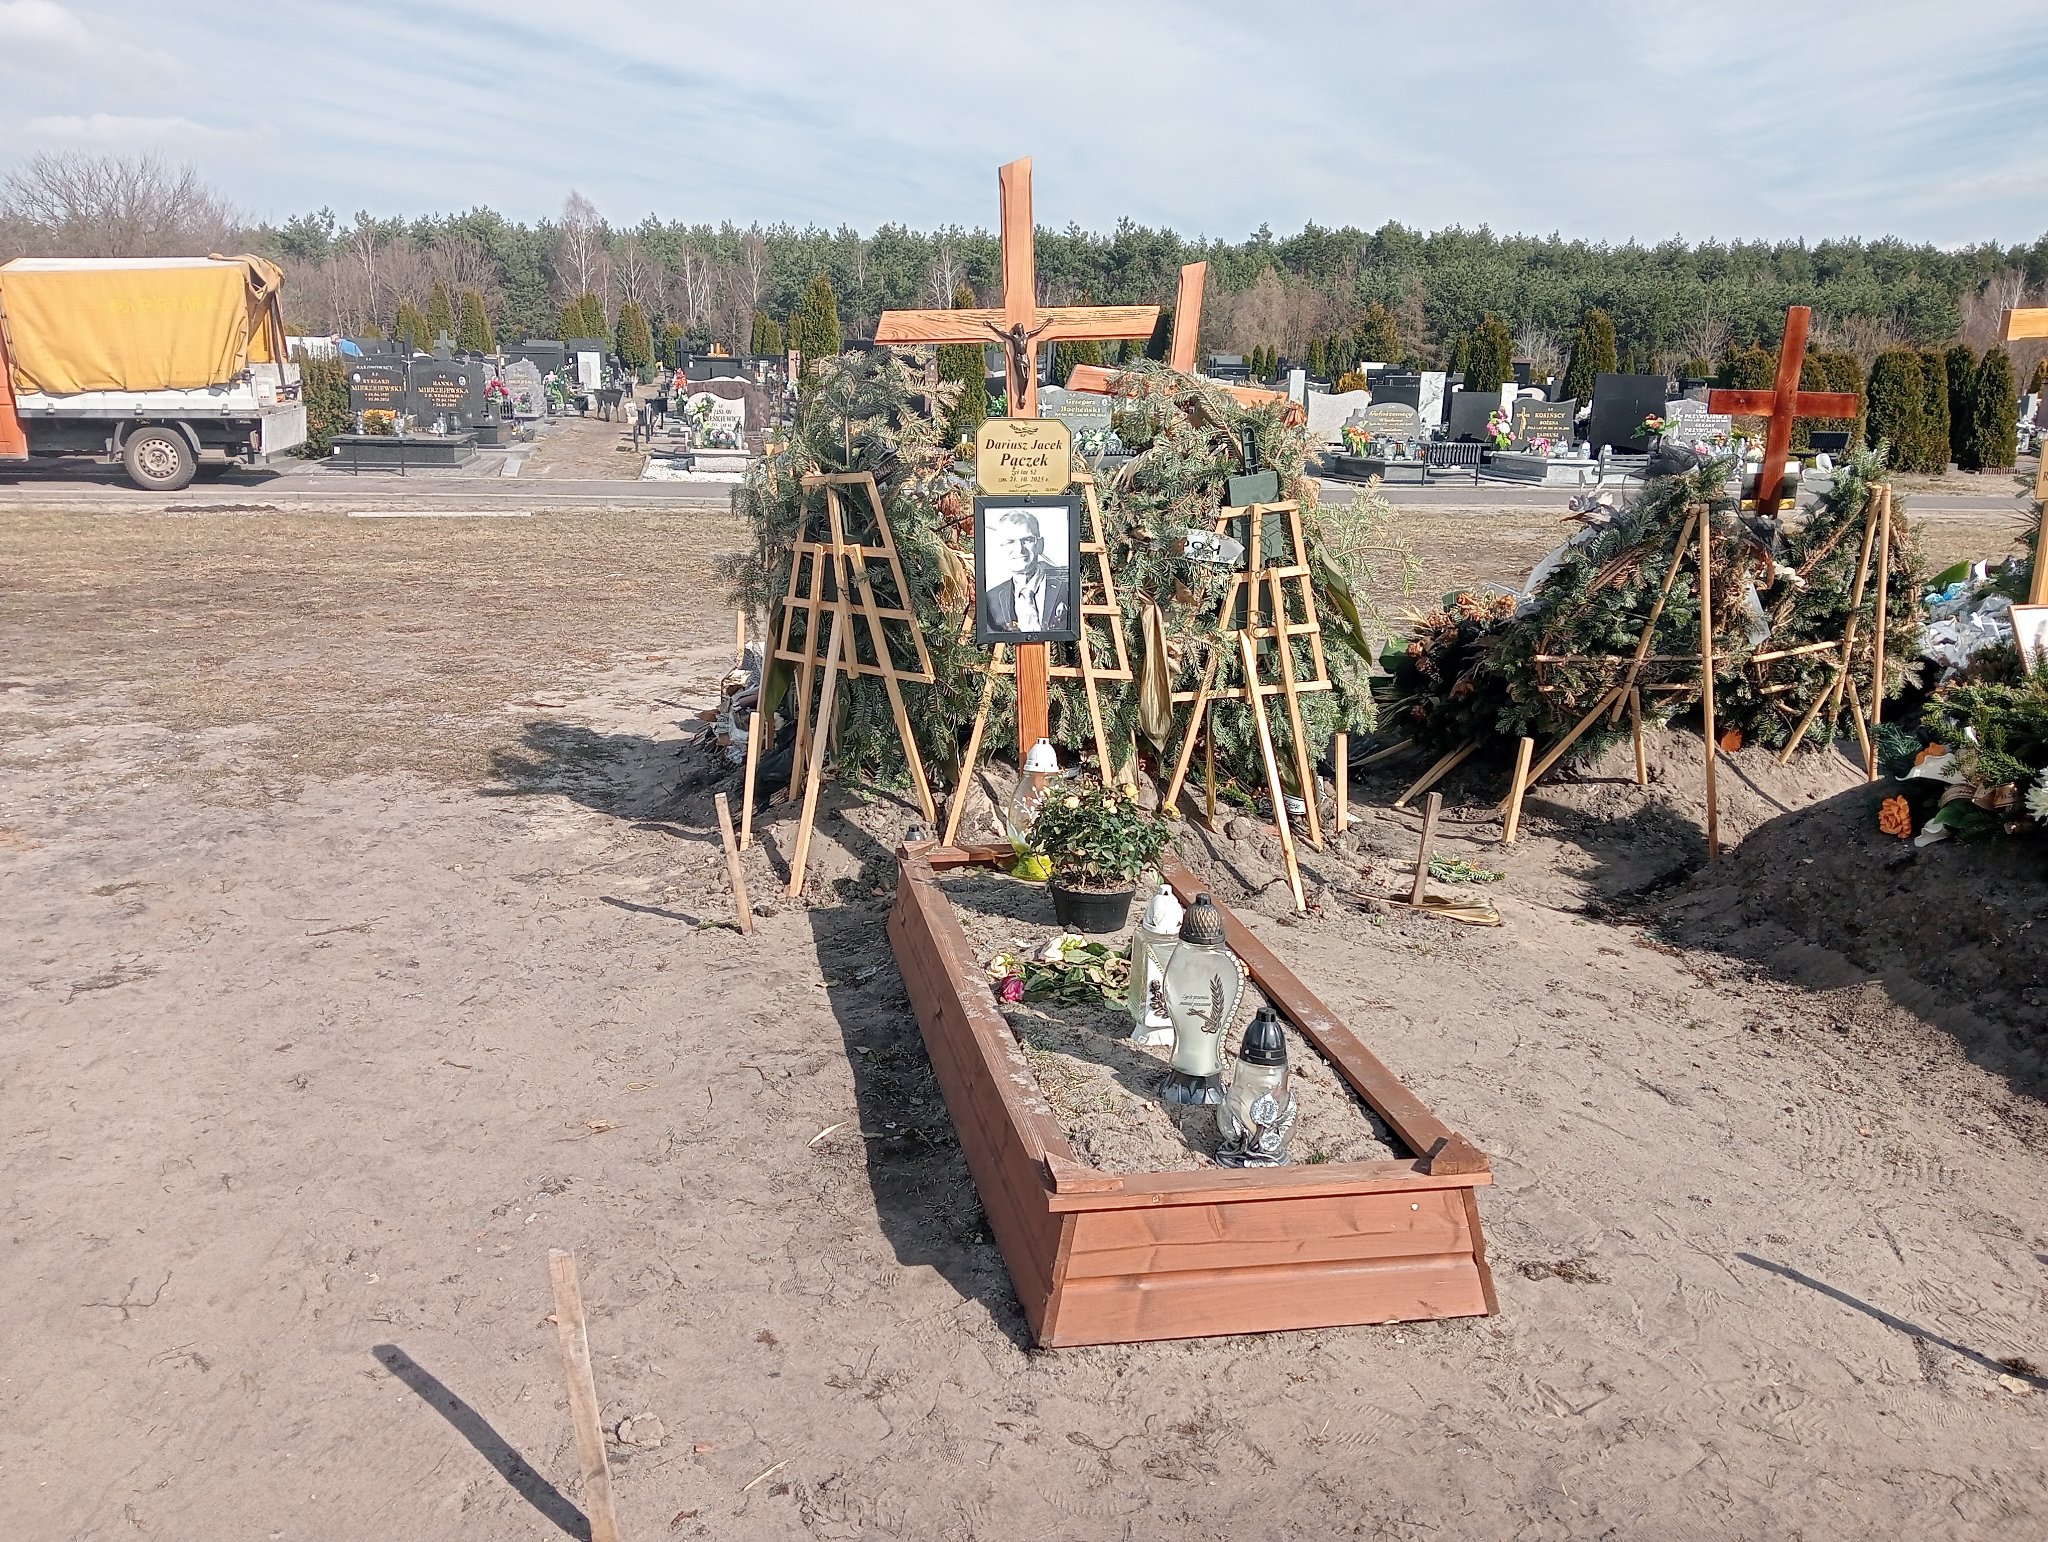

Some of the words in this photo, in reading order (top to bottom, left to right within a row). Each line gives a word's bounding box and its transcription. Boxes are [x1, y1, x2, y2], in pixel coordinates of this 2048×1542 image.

[985, 439, 1028, 450] Dariusz
[1030, 439, 1063, 450] Jacek
[1000, 453, 1048, 469] Pączek
